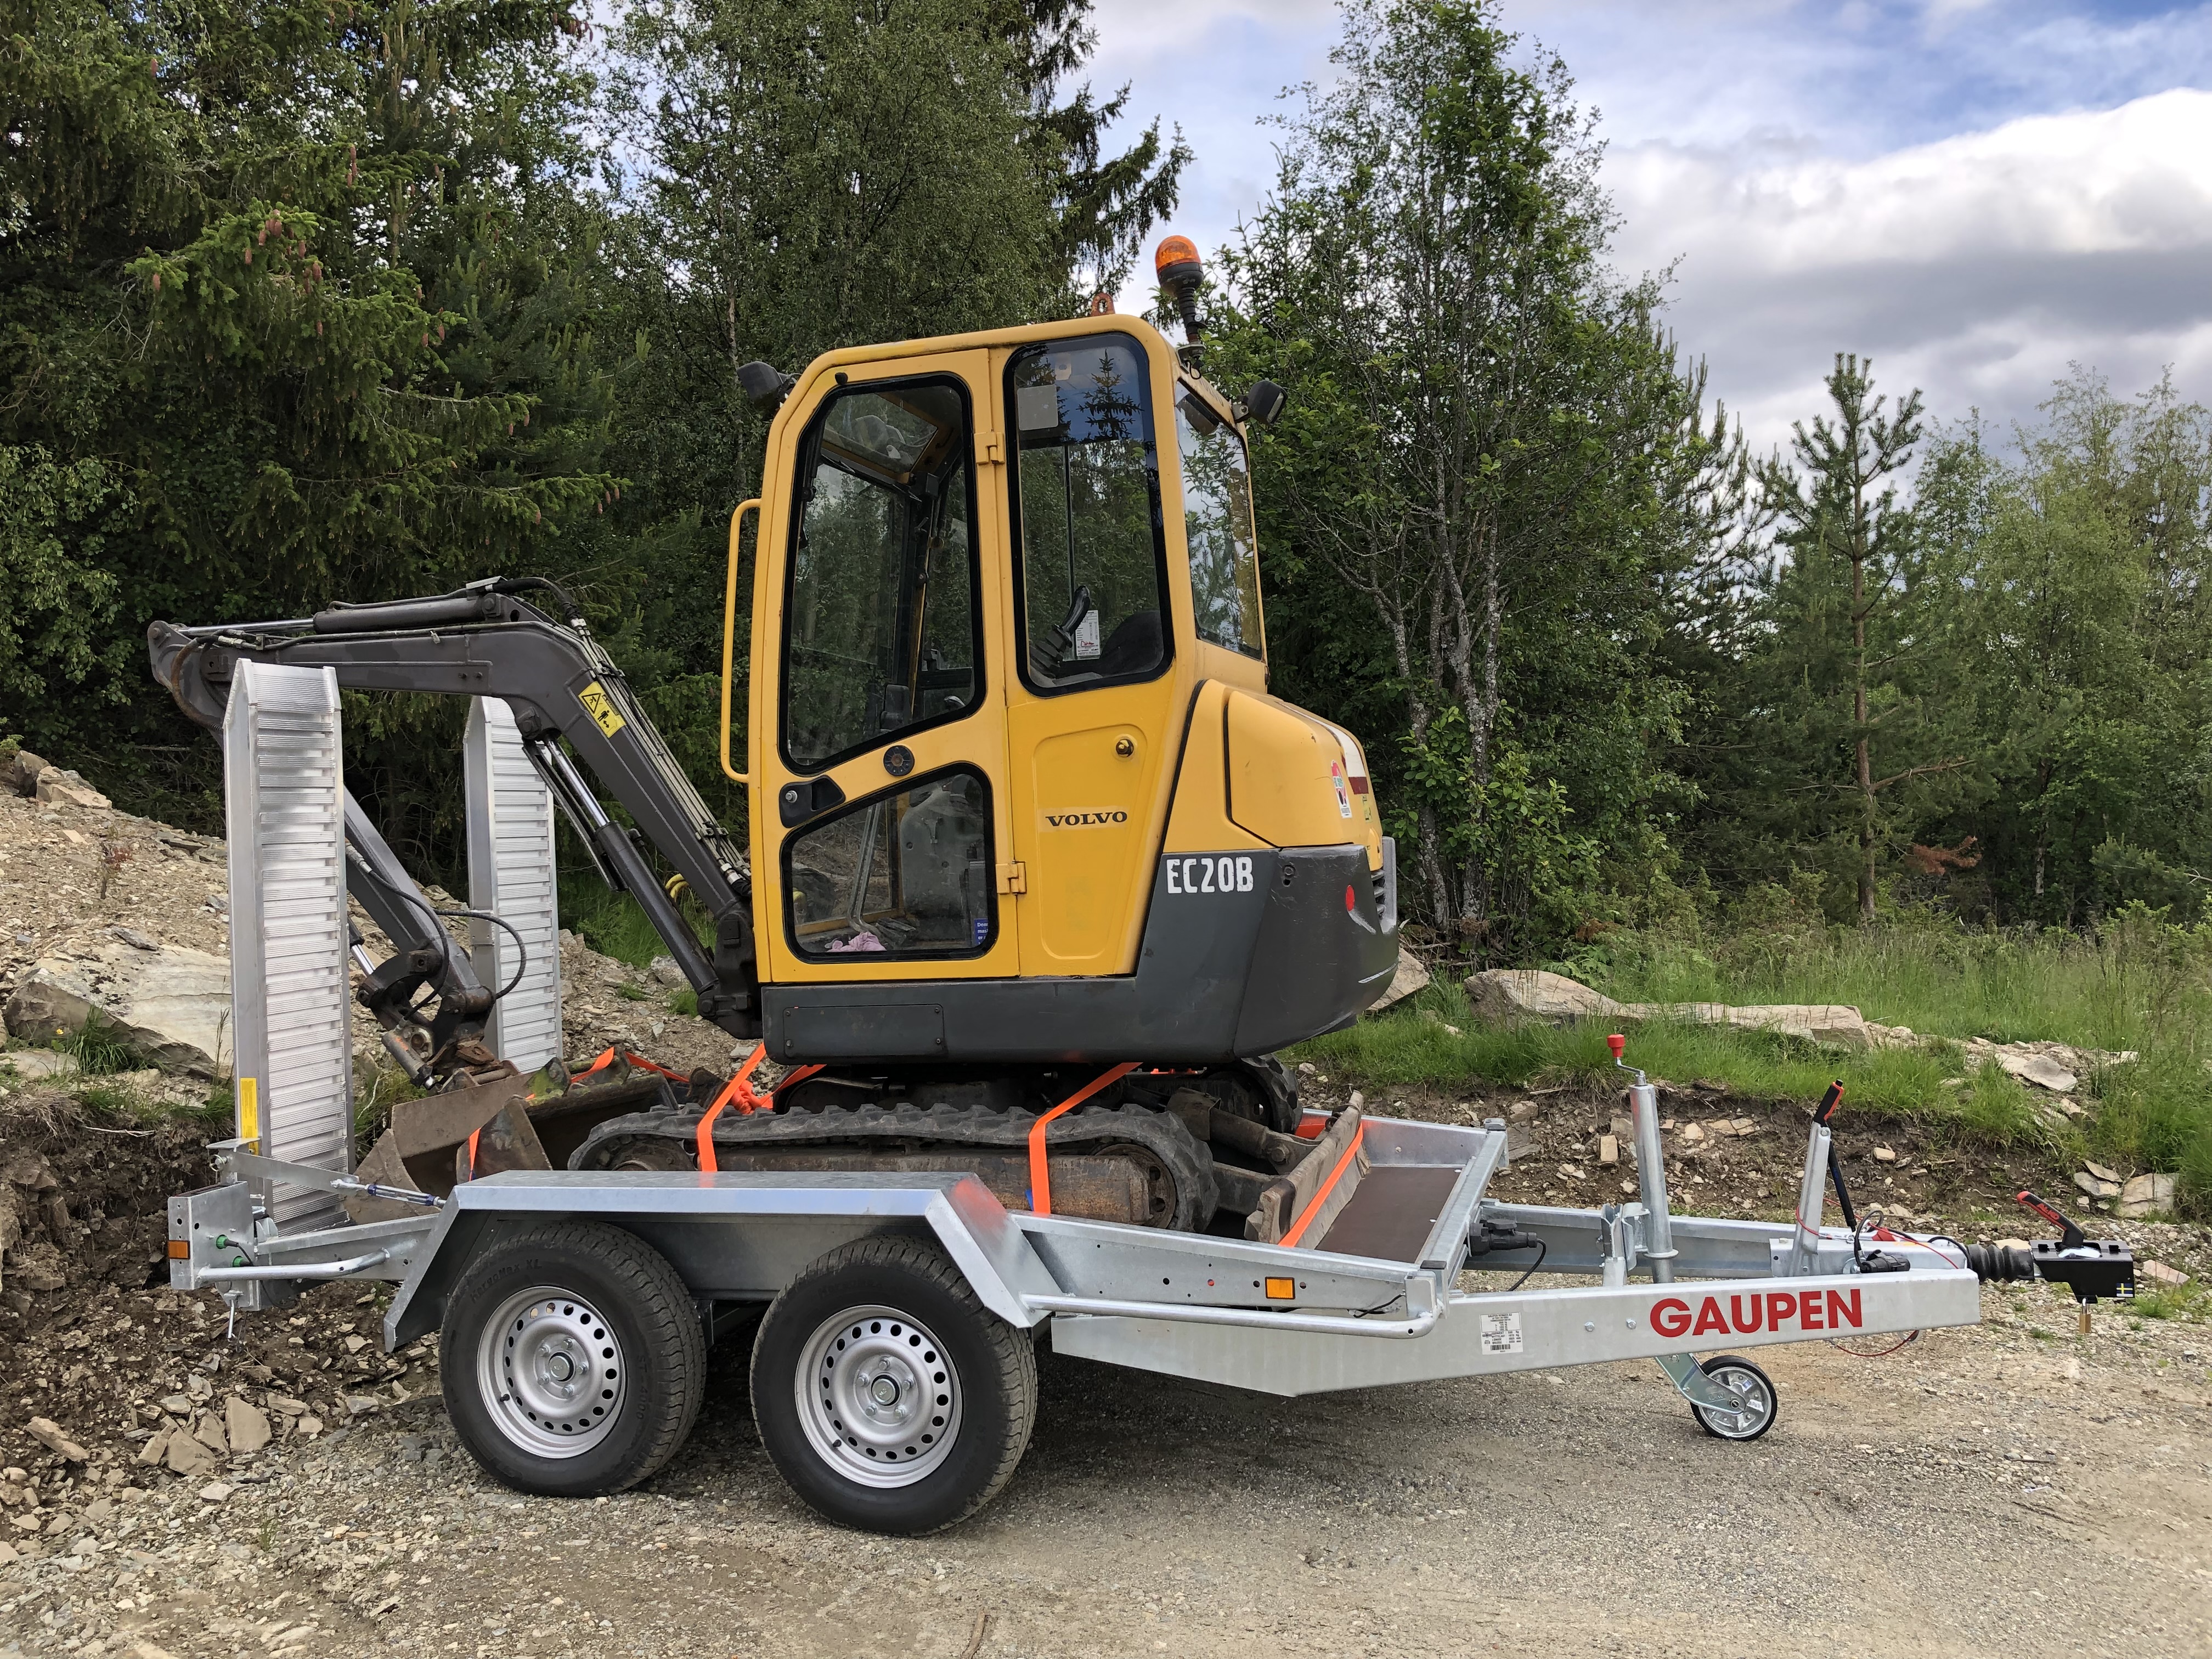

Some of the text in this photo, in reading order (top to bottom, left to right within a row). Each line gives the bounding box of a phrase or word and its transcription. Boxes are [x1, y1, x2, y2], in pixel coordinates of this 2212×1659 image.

[1045, 811, 1127, 827] VOLVO
[1166, 856, 1254, 894] EC20B
[1650, 1289, 1863, 1338] GAUPEN
